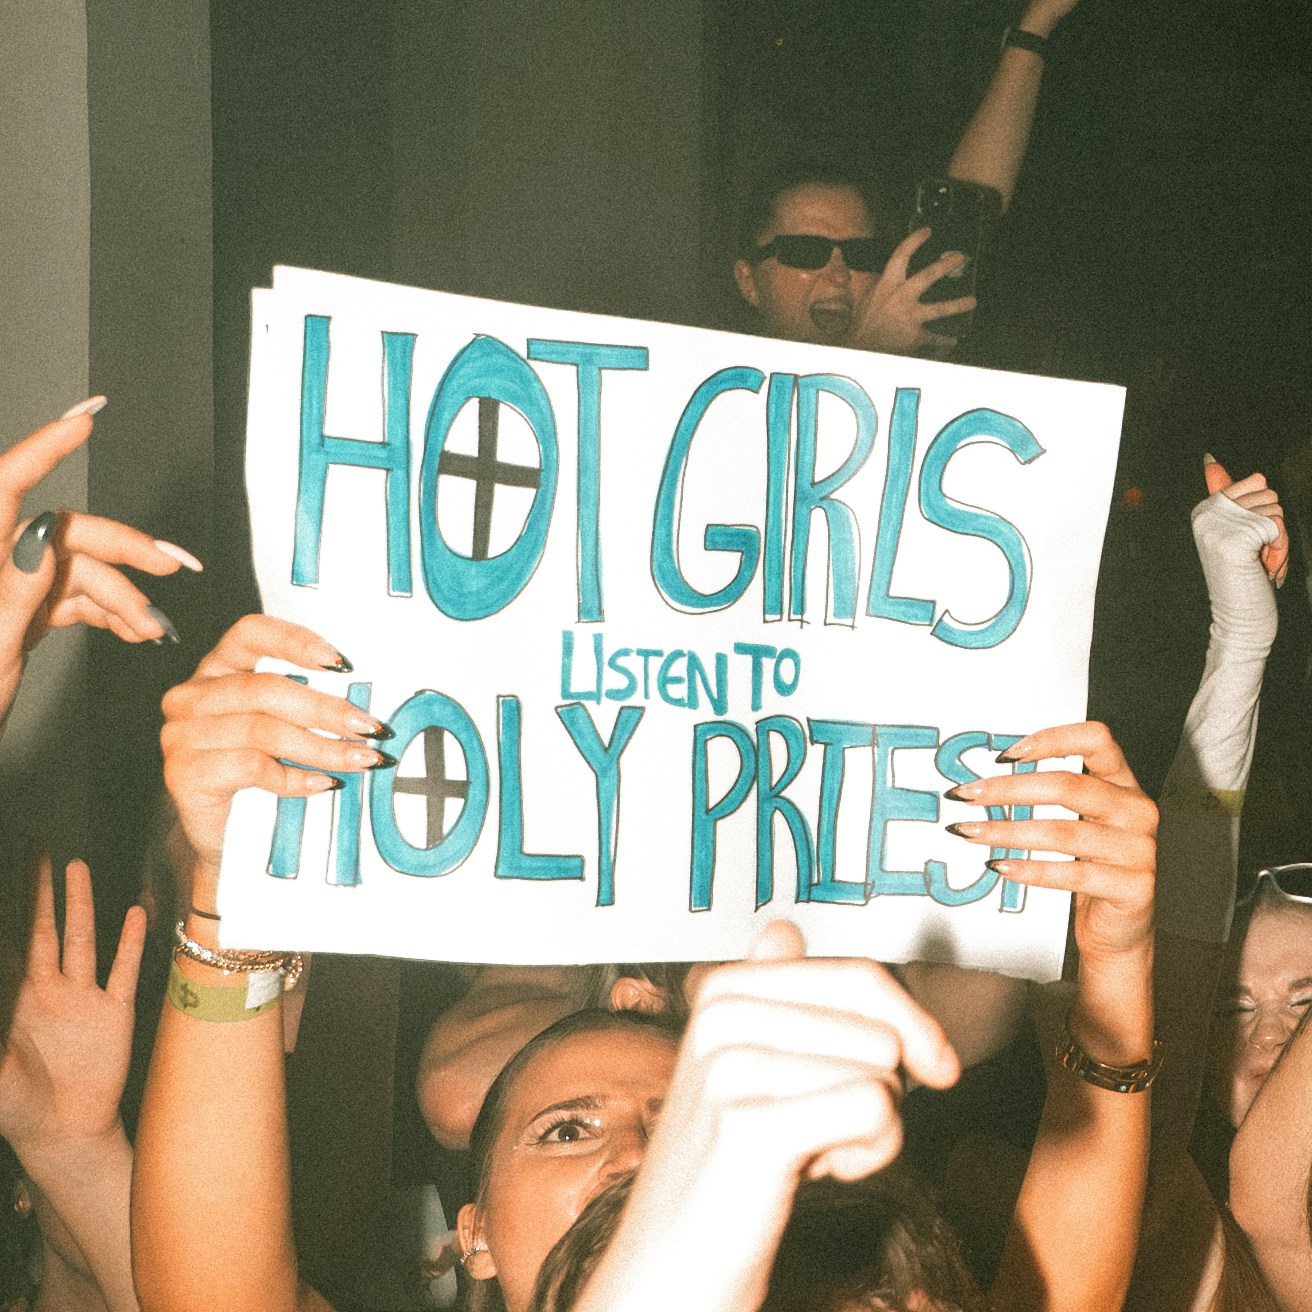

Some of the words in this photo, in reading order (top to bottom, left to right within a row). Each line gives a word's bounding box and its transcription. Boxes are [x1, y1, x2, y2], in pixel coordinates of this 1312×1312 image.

[291, 314, 649, 623] HOT
[650, 366, 1047, 649] GIRLS
[561, 630, 728, 716] LISTEN
[733, 642, 801, 711] TO
